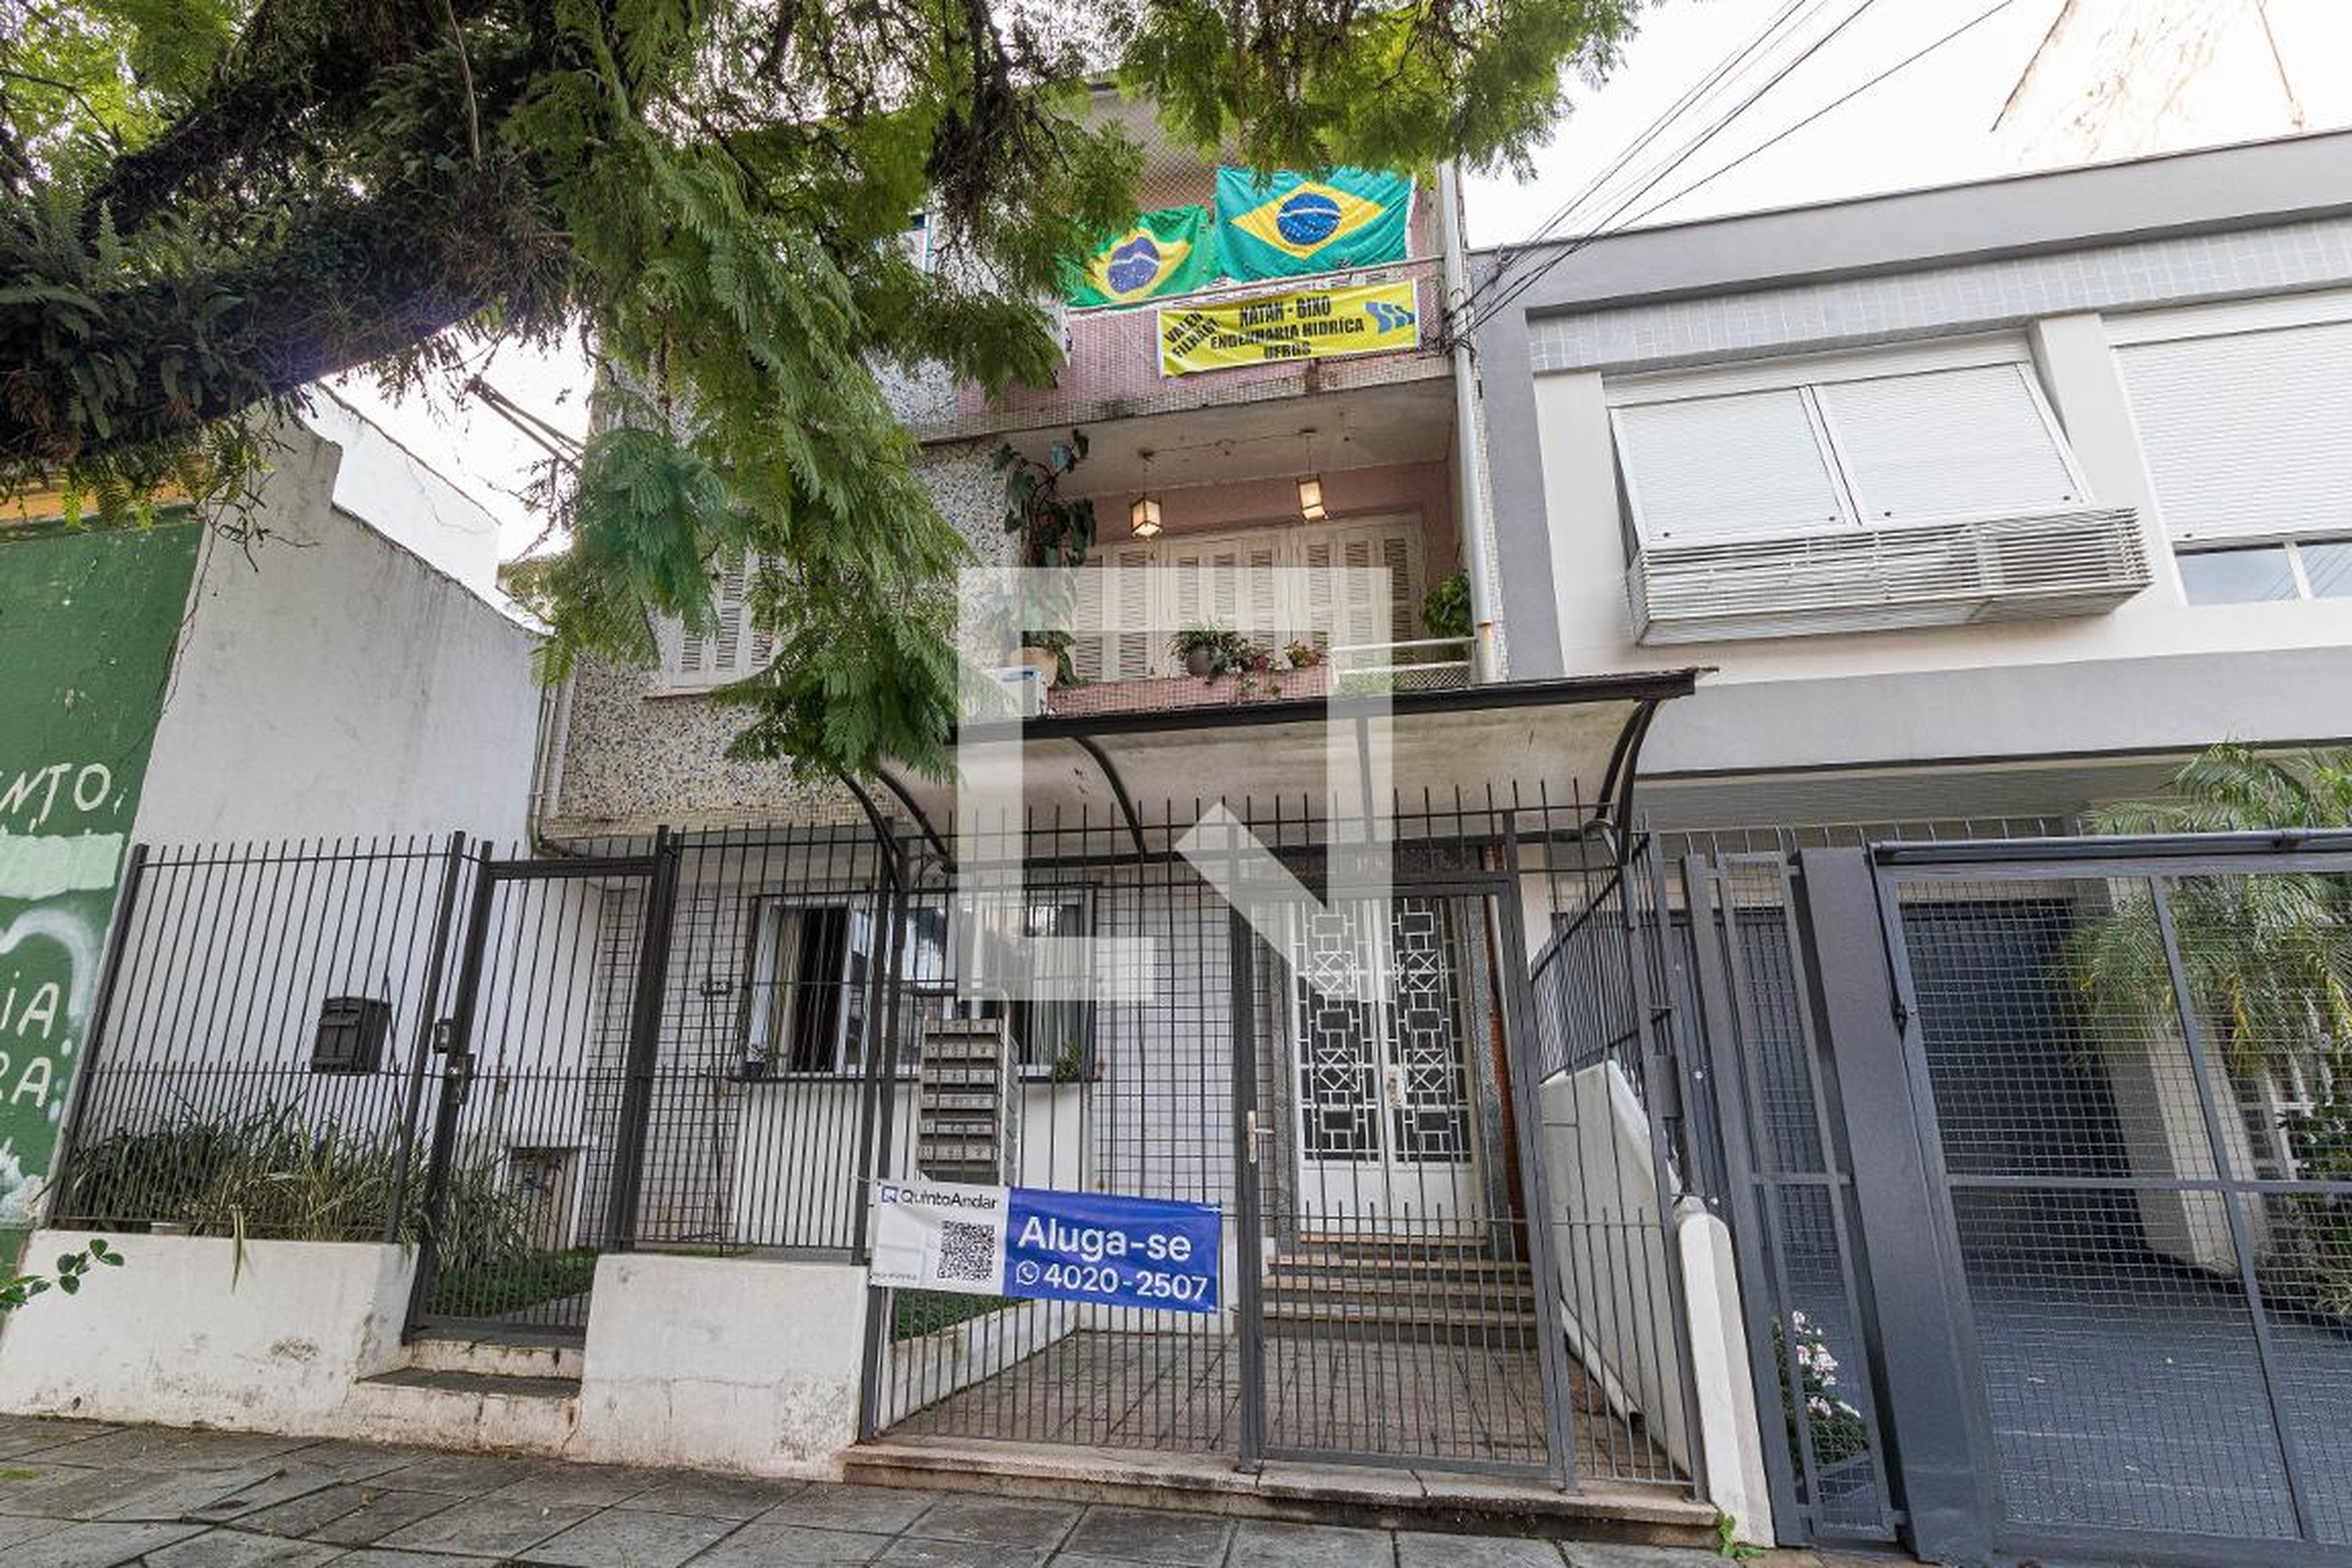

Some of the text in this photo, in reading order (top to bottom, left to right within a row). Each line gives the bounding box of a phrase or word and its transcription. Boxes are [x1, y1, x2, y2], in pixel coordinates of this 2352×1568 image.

[900, 1189, 998, 1210] QuintoAndar
[1017, 1216, 1192, 1262] Aluga-se
[1043, 1263, 1208, 1301] 4020-2507
